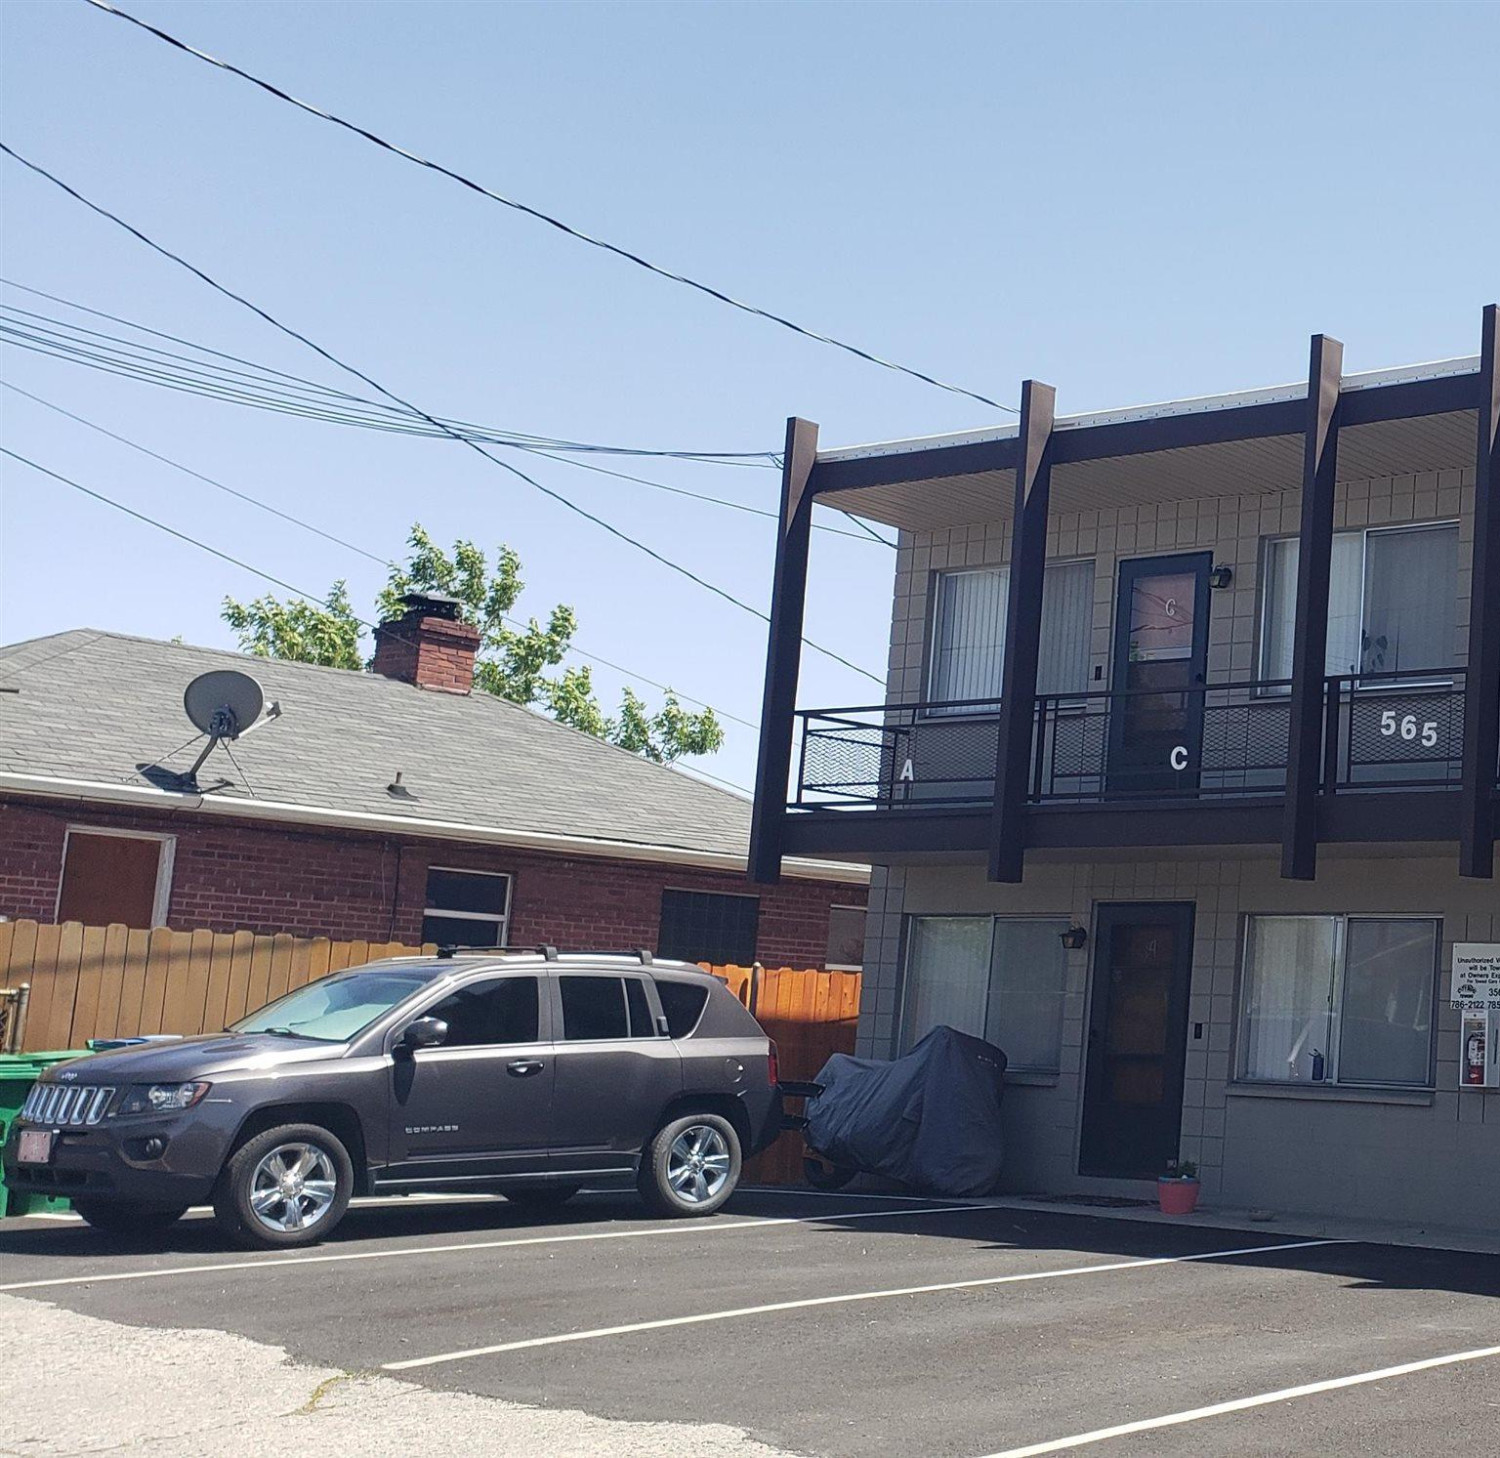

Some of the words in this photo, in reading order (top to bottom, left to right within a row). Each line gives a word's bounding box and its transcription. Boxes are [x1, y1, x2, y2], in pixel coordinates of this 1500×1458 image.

[1380, 711, 1438, 747] 565
[1170, 745, 1189, 771] C
[899, 759, 914, 781] A
[1451, 1000, 1485, 1009] 786-2122
[405, 1125, 459, 1134] COMPASS
